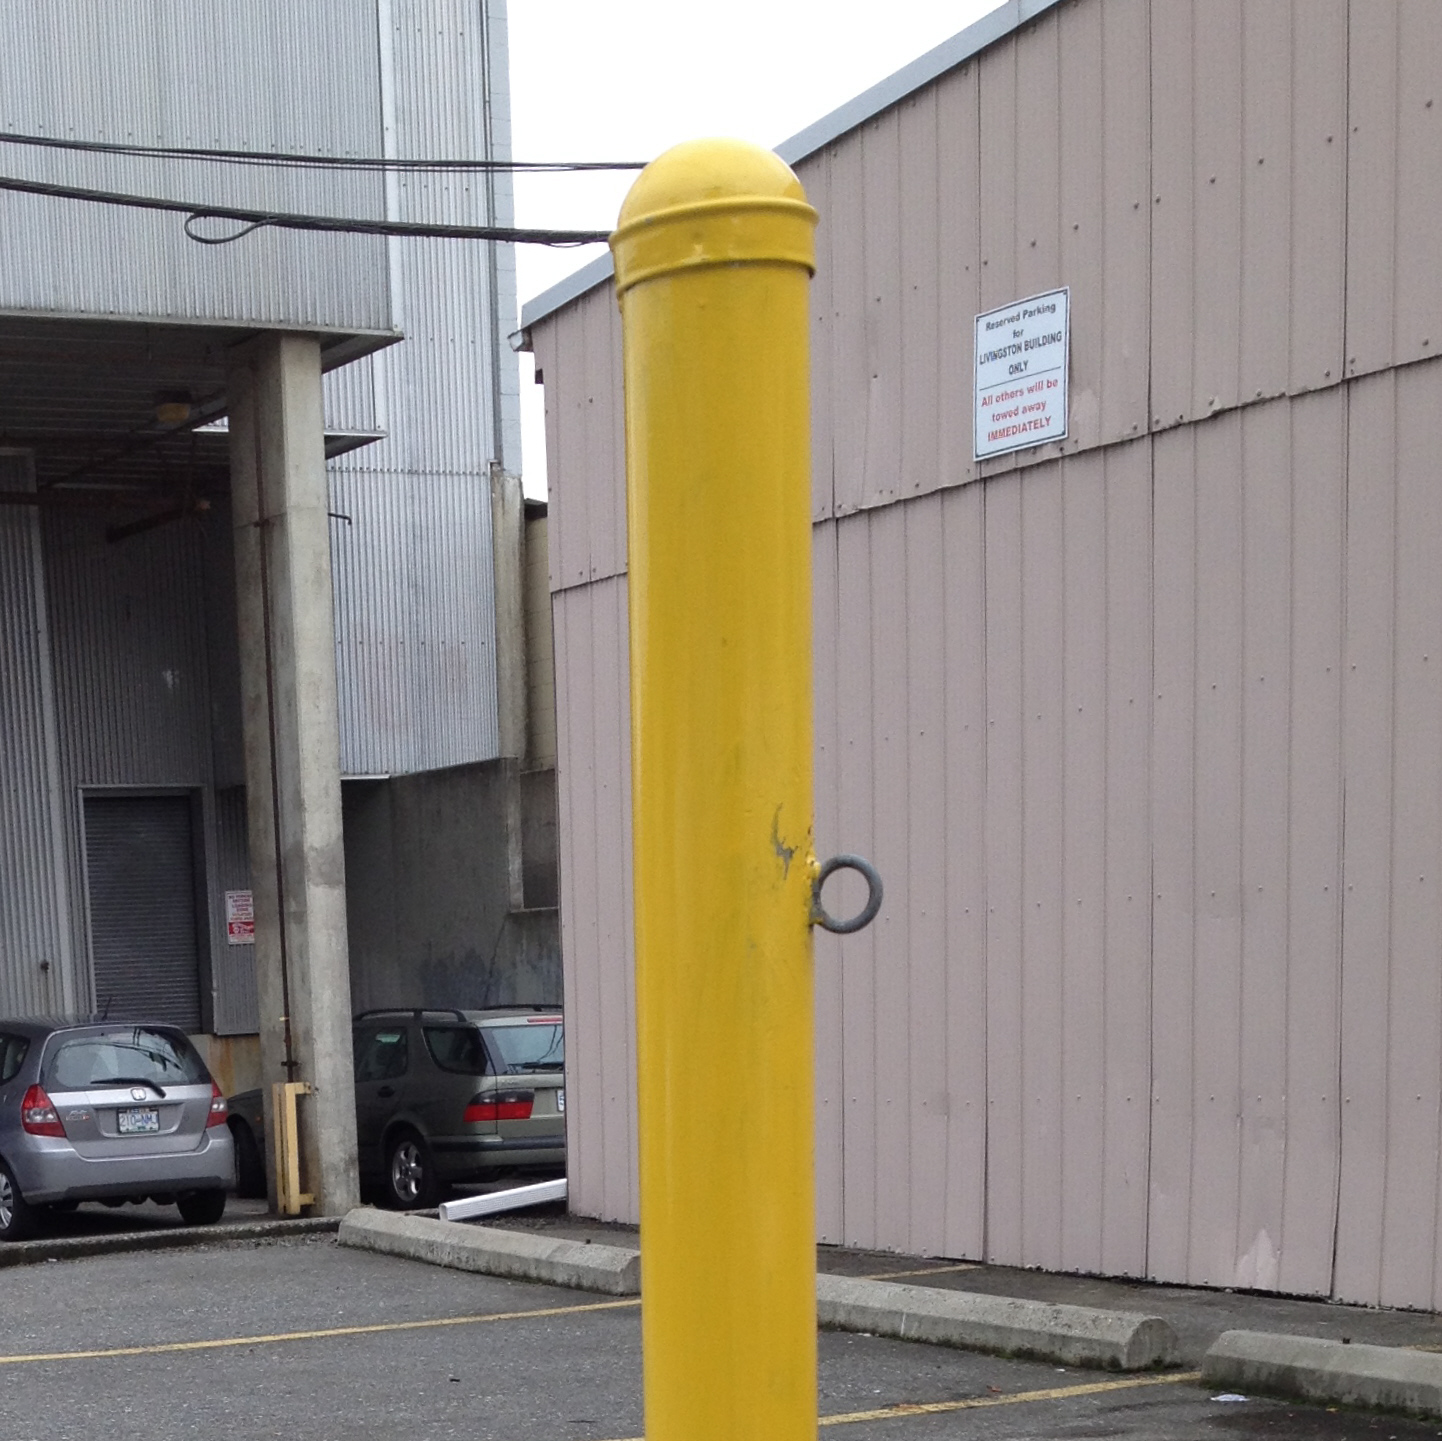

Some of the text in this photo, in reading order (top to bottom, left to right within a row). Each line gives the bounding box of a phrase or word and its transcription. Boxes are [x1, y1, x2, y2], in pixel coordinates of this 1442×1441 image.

[986, 303, 1056, 331] Reserved Parking
[979, 330, 1062, 365] LIVINGSTON BUILDING
[1012, 329, 1024, 339] for
[1008, 360, 1029, 375] ONLY
[981, 378, 1058, 408] All others will be
[992, 400, 1046, 423] towed away
[988, 415, 1052, 442] IMMEDIATELY
